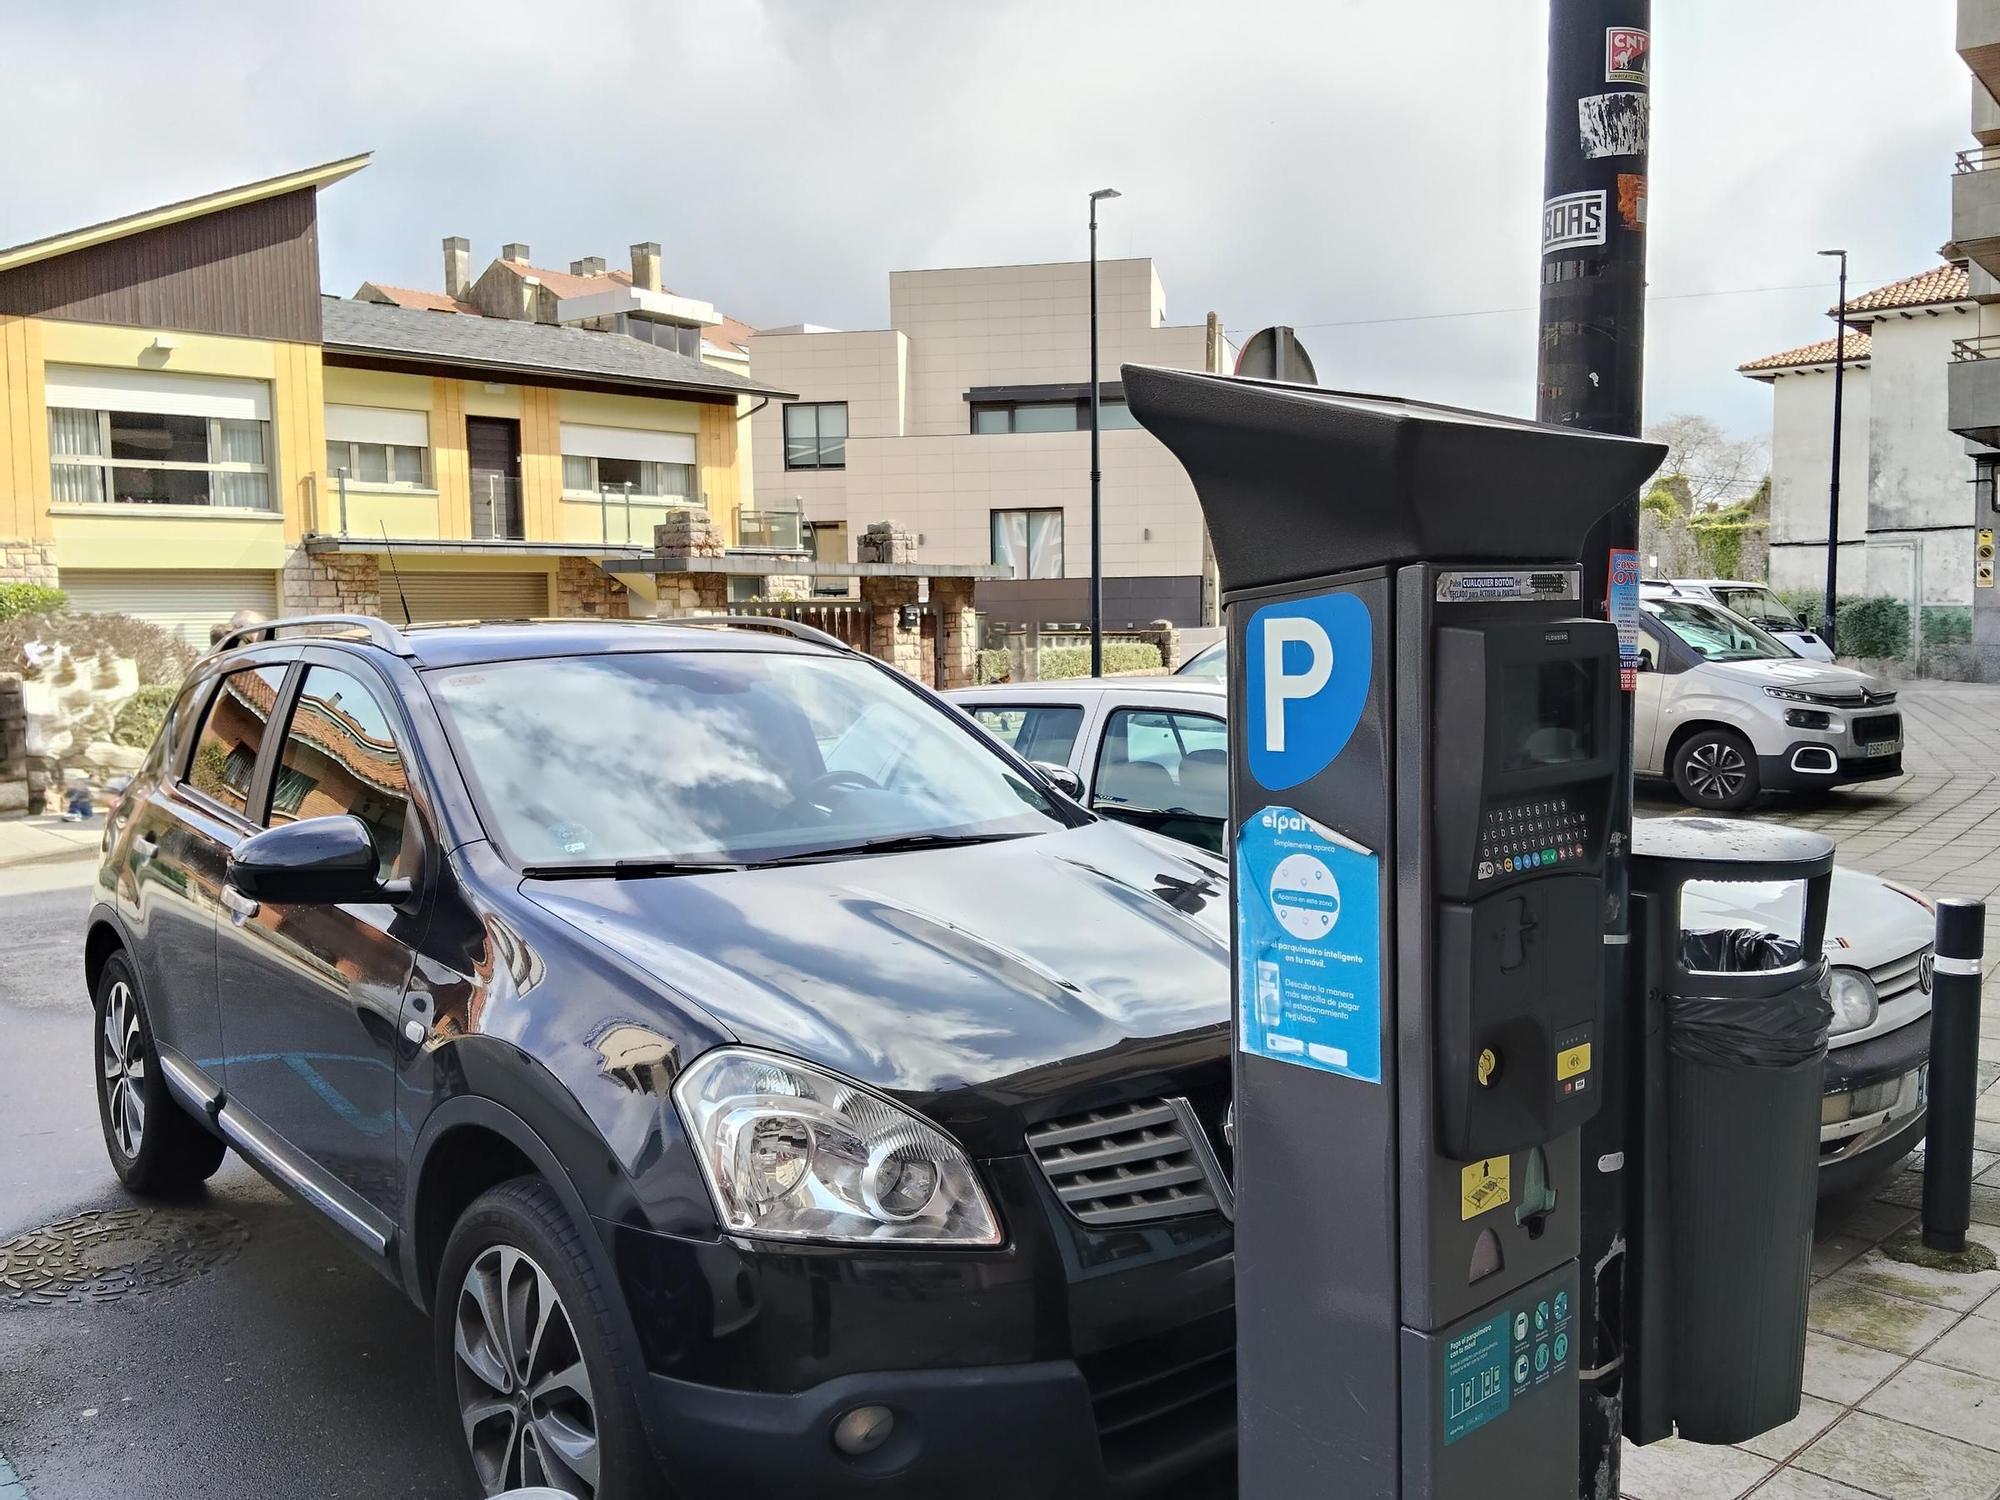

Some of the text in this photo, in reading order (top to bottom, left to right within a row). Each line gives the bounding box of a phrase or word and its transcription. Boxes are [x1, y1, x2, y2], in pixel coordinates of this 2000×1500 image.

[1614, 34, 1645, 51] CNT
[1463, 579, 1494, 587] CUALQUIER
[1495, 577, 1513, 587] BOTÓN
[1264, 617, 1333, 752] P
[1273, 839, 1336, 853] Simplemente aparca
[1278, 942, 1323, 957] parquímetro
[1324, 948, 1364, 964] inteligente
[1285, 955, 1326, 969] en tu móvil.
[1285, 978, 1354, 999] Descubre la manera
[1285, 990, 1360, 1012] más sencilla de pagar
[1285, 1011, 1318, 1024] regulado.
[1292, 1003, 1349, 1020] estacionamiento
